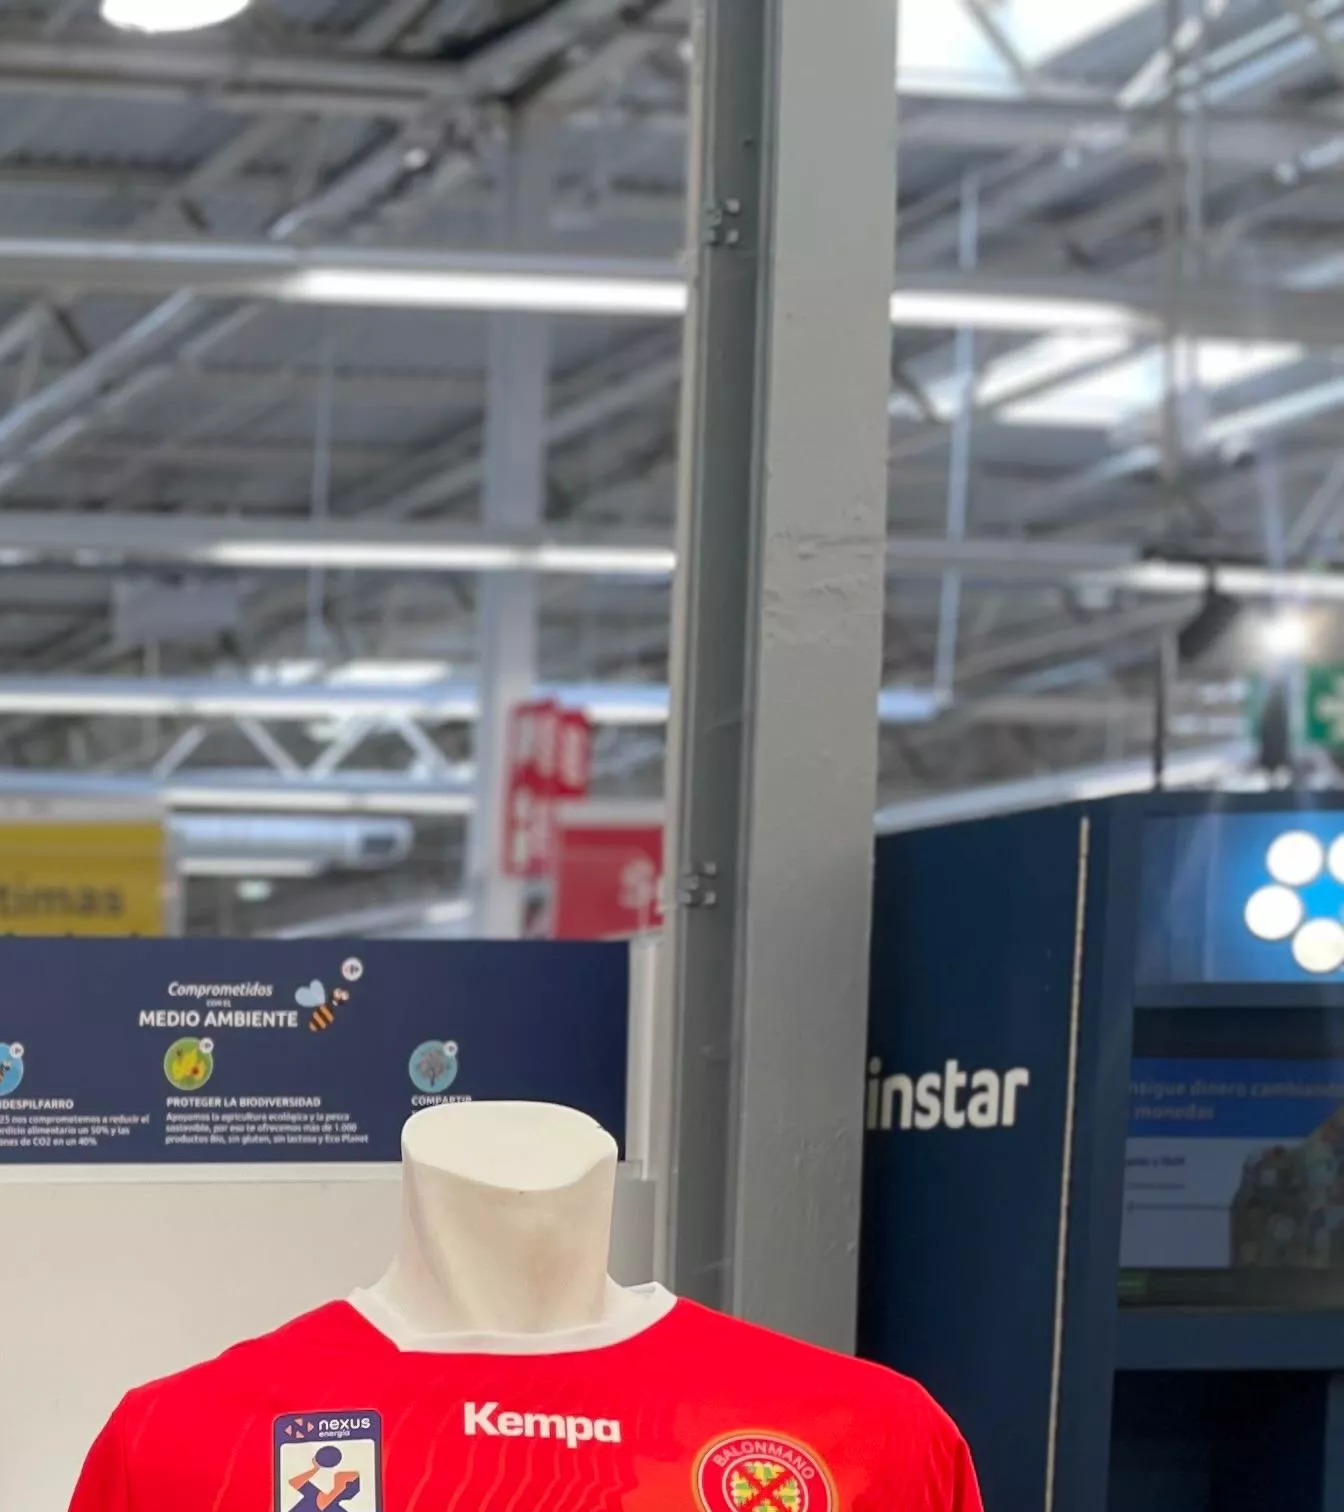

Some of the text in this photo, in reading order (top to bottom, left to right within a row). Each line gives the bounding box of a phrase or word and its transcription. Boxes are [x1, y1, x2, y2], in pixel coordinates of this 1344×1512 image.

[167, 981, 273, 999] Comprometidos
[139, 1010, 299, 1027] MEDIO AMBIENTE
[166, 1097, 321, 1108] PROTEGER LA BIODIVERSIDAD
[318, 1415, 371, 1432] nexus
[464, 1402, 622, 1449] Kempa
[712, 1439, 817, 1481] BALONMANO
